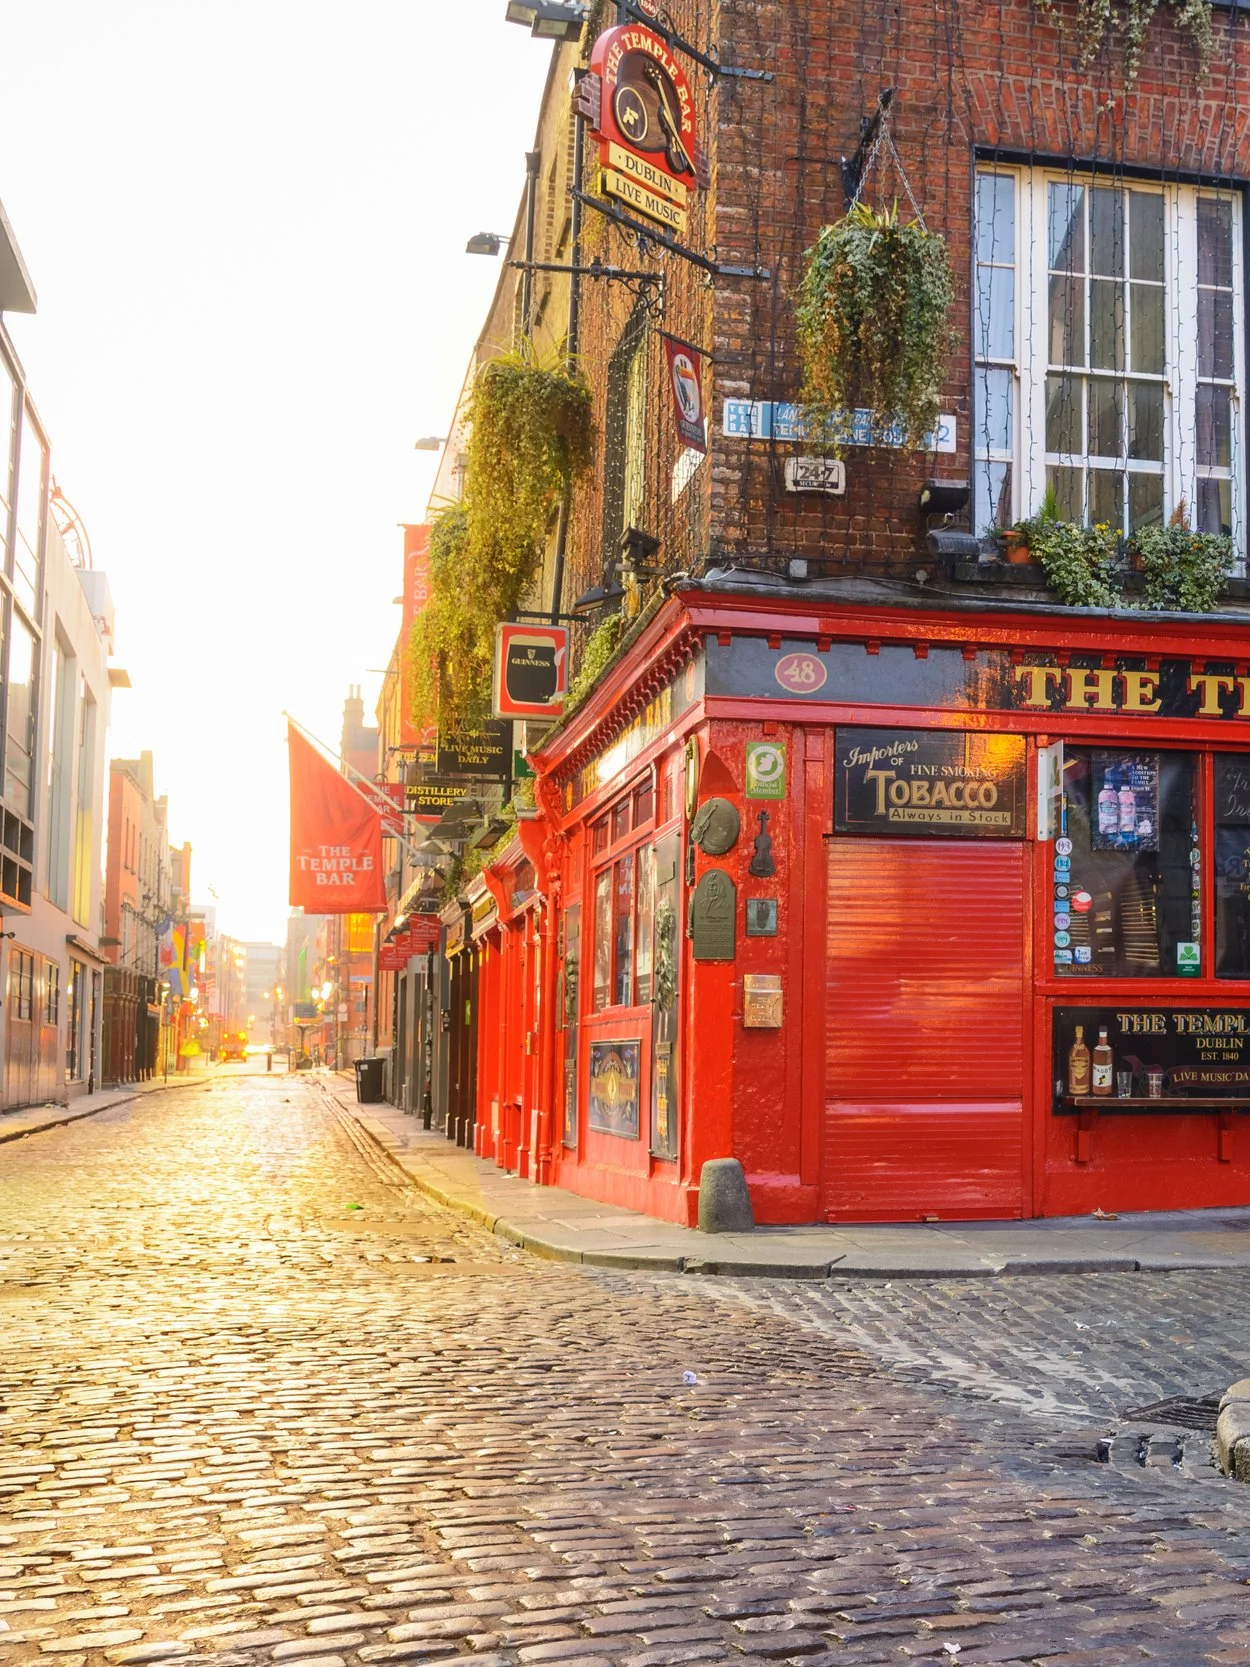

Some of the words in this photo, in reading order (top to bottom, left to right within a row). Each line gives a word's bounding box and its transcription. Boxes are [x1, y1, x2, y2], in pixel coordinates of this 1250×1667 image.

[606, 42, 624, 85] THE
[621, 32, 678, 80] TEMPLE
[676, 84, 692, 135] BAR
[625, 155, 672, 194] DUBLIN
[616, 178, 642, 204] LIVE
[645, 195, 681, 225] MUSIC
[729, 405, 757, 416] TEM
[729, 413, 757, 426] PLE
[729, 423, 757, 435] BAR
[413, 564, 427, 600] BAR
[512, 658, 550, 667] GUINNESS
[783, 659, 816, 684] 48
[1014, 665, 1164, 712] THE
[445, 744, 468, 753] LIVE
[470, 746, 504, 755] MUSIC
[843, 738, 919, 769] Importers
[457, 755, 489, 764] DAILY
[890, 757, 905, 767] OF
[910, 764, 939, 777] FINE
[940, 765, 997, 778] SMOKING
[406, 785, 467, 797] DISTILLERY
[753, 787, 781, 795] Member
[863, 769, 999, 816] TOBACCO
[418, 796, 455, 806] STORE
[891, 809, 943, 822] Always
[950, 811, 962, 822] in
[968, 810, 1009, 824] Stock
[318, 846, 351, 857] THE
[297, 856, 375, 871] TEMPLE
[315, 872, 355, 886] BAR
[1117, 1013, 1166, 1034] THE
[1196, 1038, 1244, 1049] DUBLIN
[1200, 1052, 1219, 1061] EST.
[1222, 1052, 1240, 1061] 1840
[1173, 1071, 1198, 1083] LIVE
[1201, 1072, 1232, 1083] MUSIC
